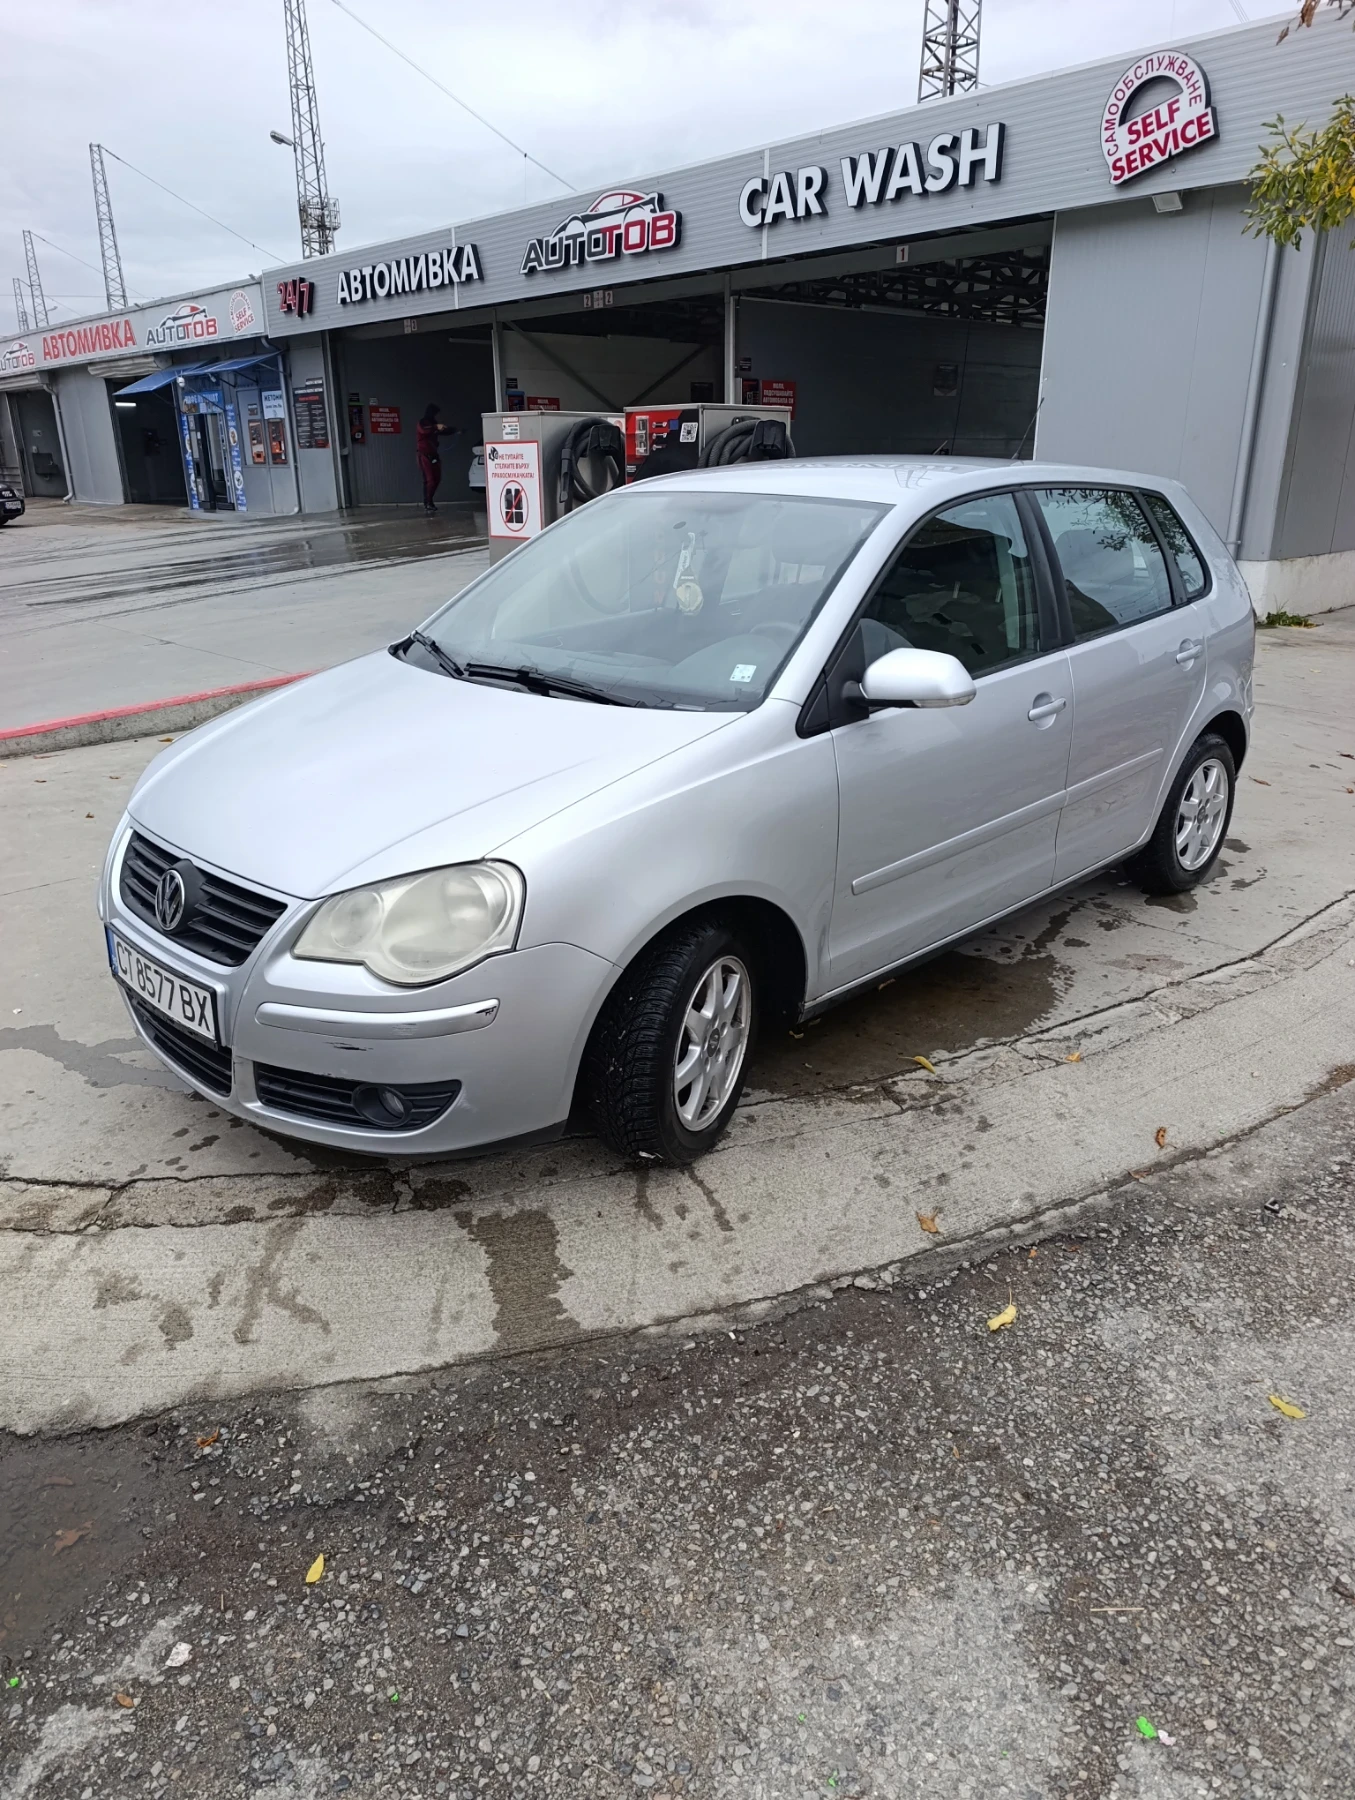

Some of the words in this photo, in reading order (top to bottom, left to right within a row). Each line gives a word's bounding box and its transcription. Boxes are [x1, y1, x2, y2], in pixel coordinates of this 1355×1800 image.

[1104, 55, 1202, 157] САМООБСЛУЖВАНЕ
[1127, 98, 1180, 145] SELF
[1112, 111, 1211, 181] SERVICE
[739, 165, 824, 228] CAR
[841, 122, 1004, 208] WASH
[277, 278, 312, 317] 24/7
[337, 243, 479, 304] АВТОМИВКА
[235, 313, 254, 333] SERVICE
[236, 307, 247, 321] SELF
[0, 353, 35, 371] UTOTOB
[42, 319, 136, 361] АВТОМИВКА
[136, 957, 175, 1011] 8577
